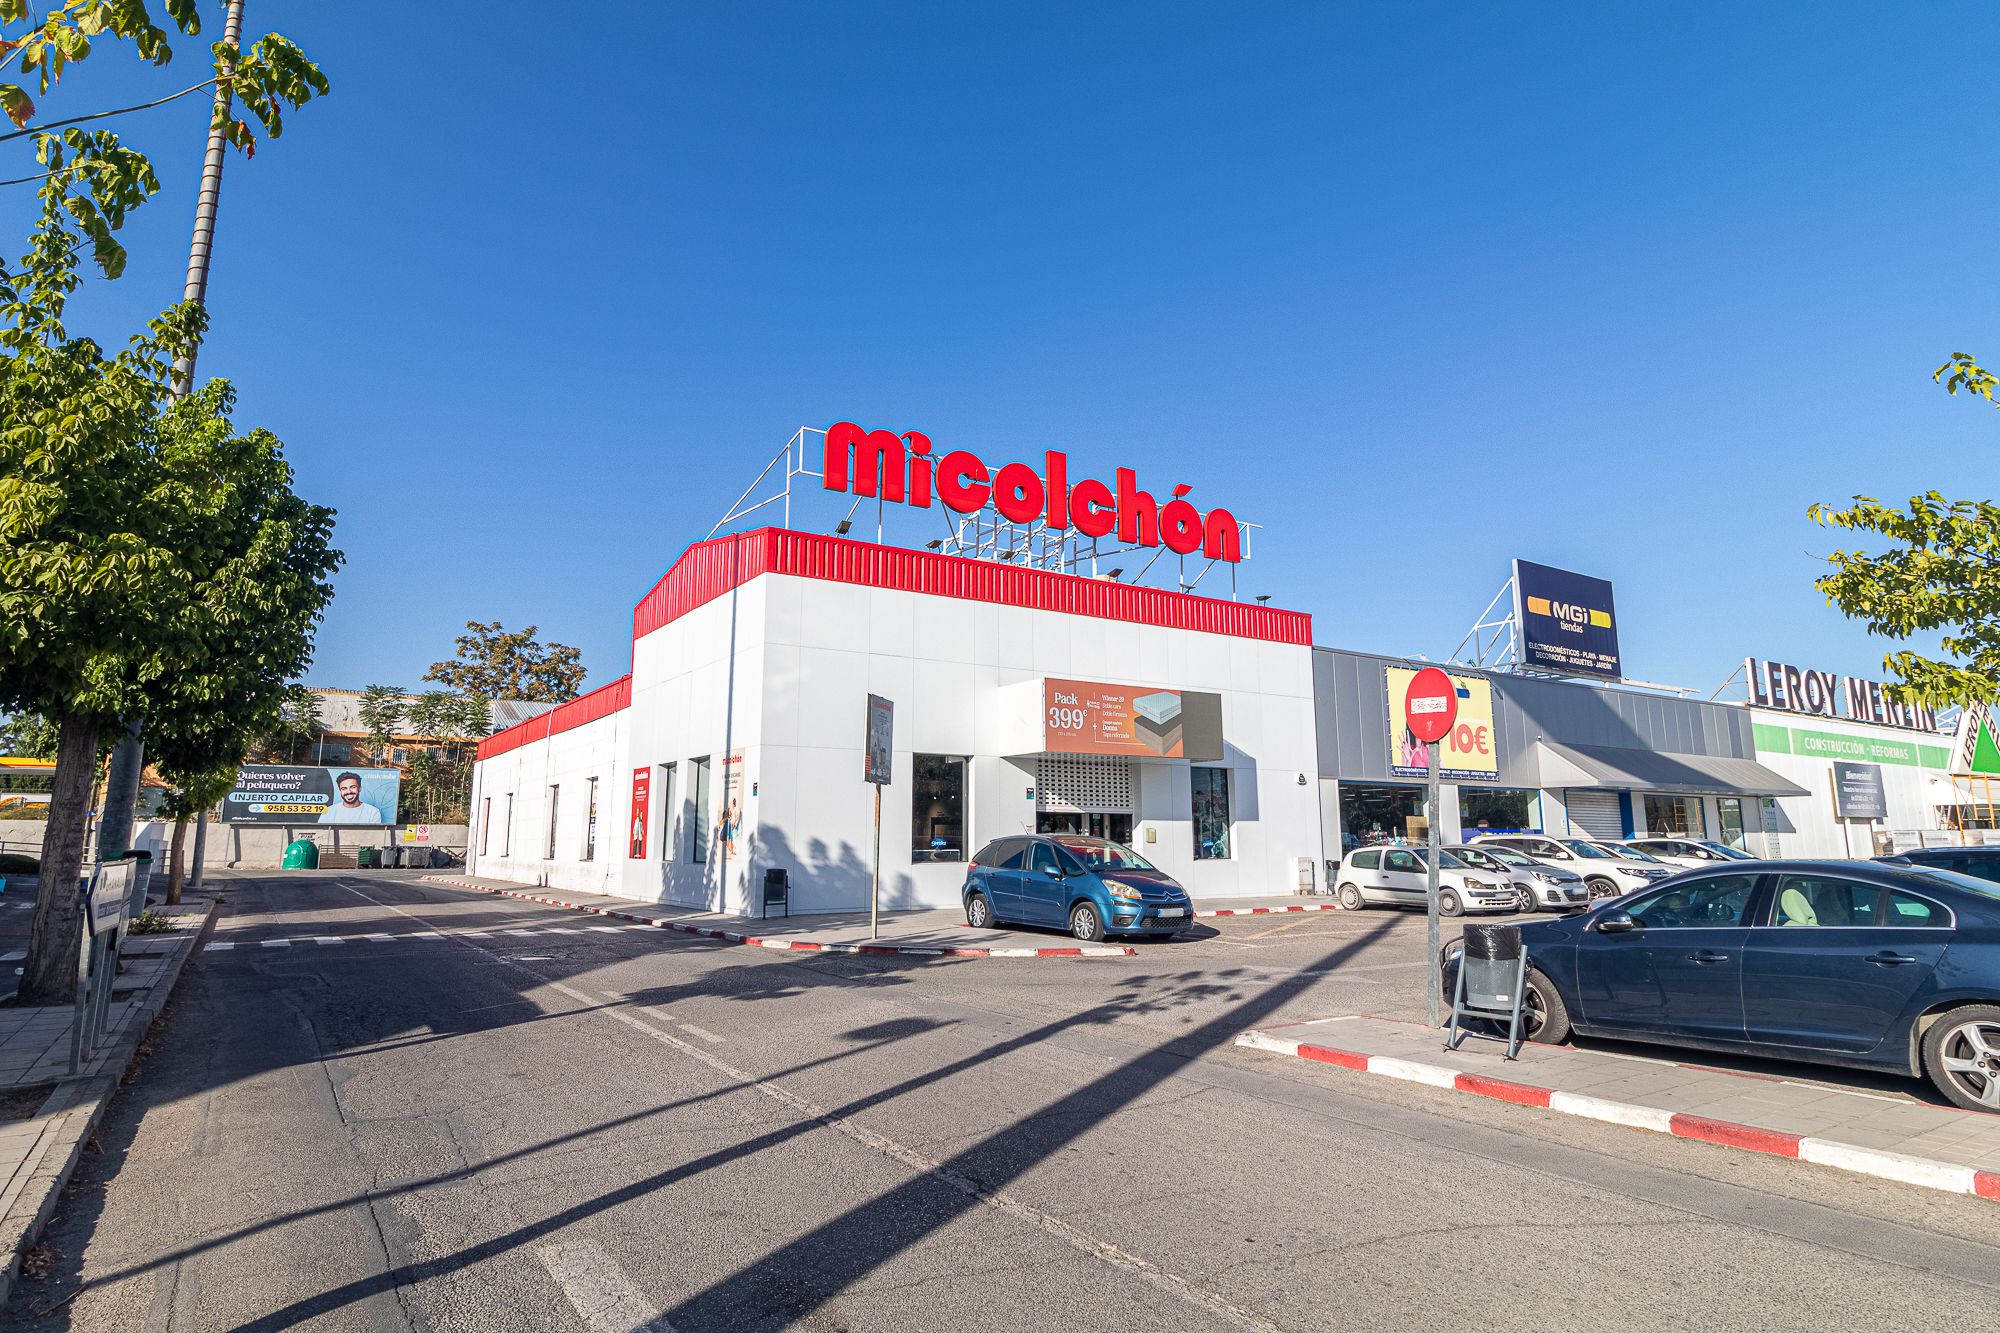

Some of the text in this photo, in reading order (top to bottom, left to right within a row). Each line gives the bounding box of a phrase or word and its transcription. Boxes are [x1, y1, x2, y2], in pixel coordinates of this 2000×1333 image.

[823, 421, 1241, 563] micolchón
[1553, 601, 1588, 624] MGi
[1560, 620, 1583, 633] tiendas
[1528, 641, 1617, 664] ELECTRODOMÉSTICOS PLAYA MENAJE
[1535, 651, 1612, 670] DECORACIÓN JUGUETES JARDÍN
[1745, 657, 1837, 716] LEROY
[1054, 692, 1078, 705] Pack
[1450, 723, 1489, 755] 10€
[1804, 737, 1909, 760] CONSTRUCCIÓN REFORMAS
[247, 781, 301, 790] peluquero?
[276, 772, 306, 780] volver
[234, 793, 323, 802] INJERTO CAPILAR
[314, 805, 324, 813] 19
